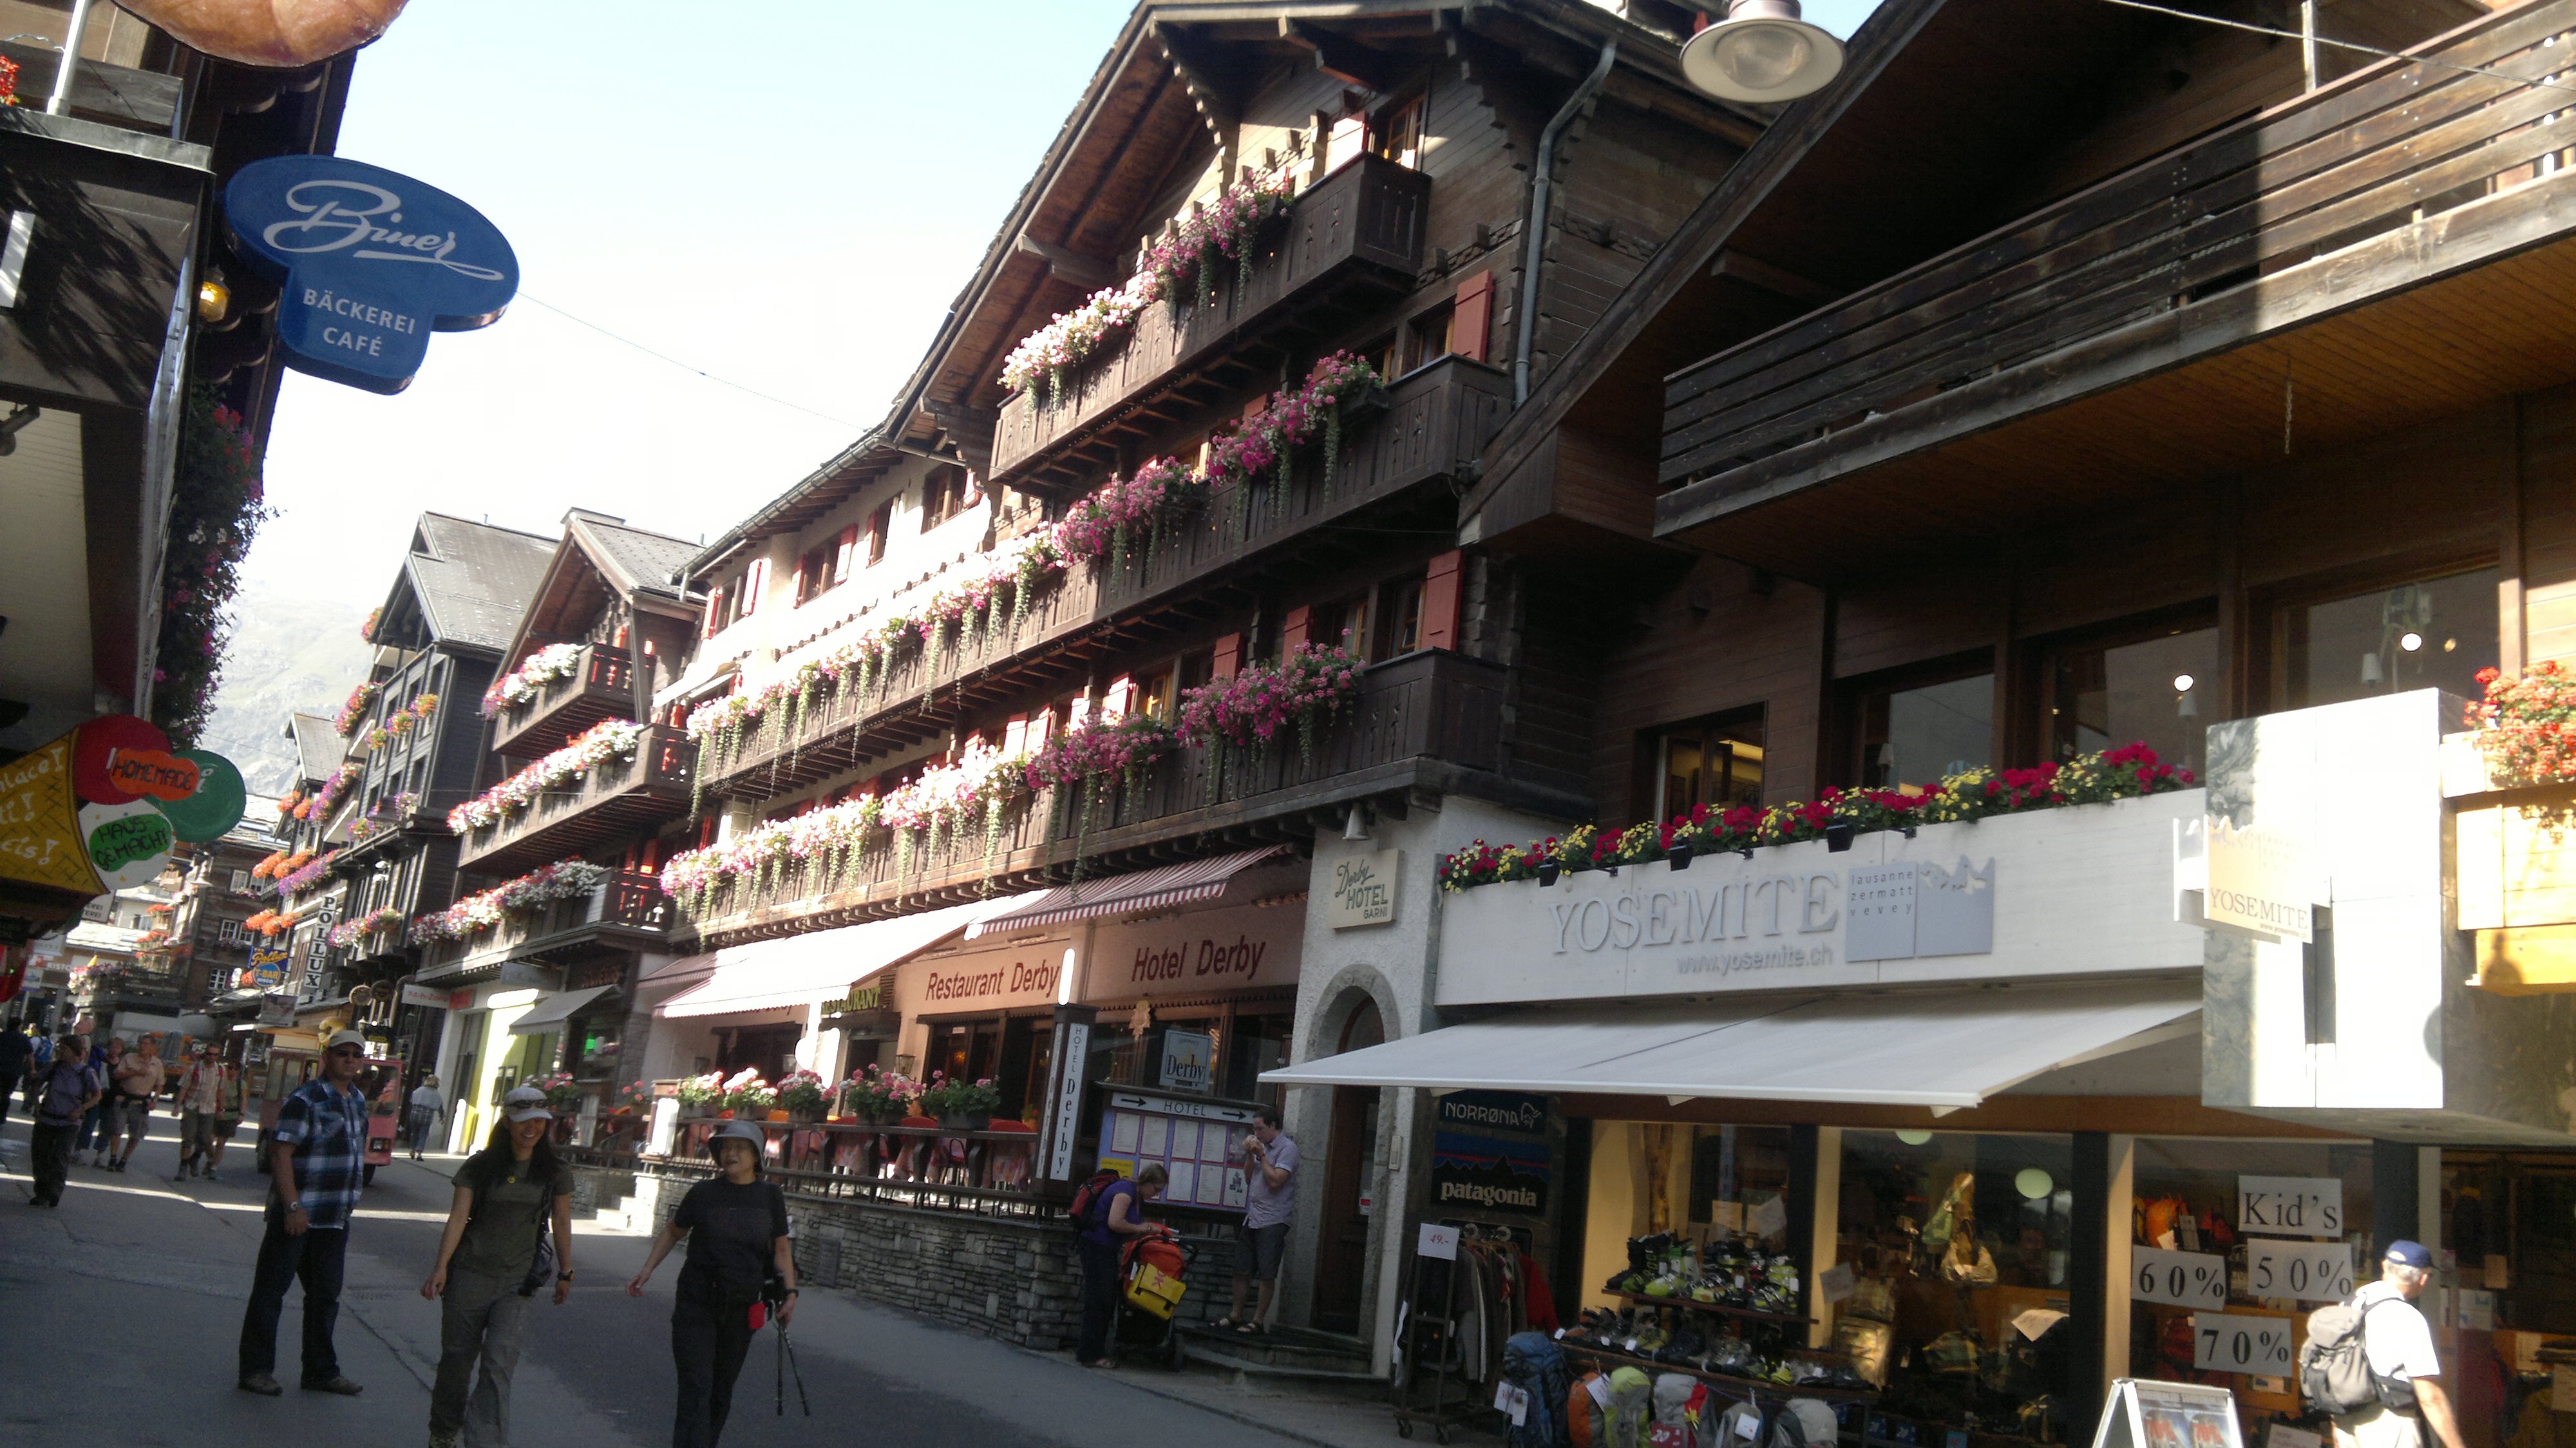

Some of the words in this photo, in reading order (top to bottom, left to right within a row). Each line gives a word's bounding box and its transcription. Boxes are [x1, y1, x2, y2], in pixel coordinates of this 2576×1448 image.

[263, 179, 505, 281] Biner
[303, 288, 416, 335] BÄCKEREI
[323, 326, 384, 357] CAFÉ
[97, 815, 147, 843] HAUS
[96, 828, 169, 872] GEMACHT
[1335, 859, 1375, 898] Derby
[1345, 884, 1388, 910] HOTEL
[1851, 886, 1912, 901] zermatt
[1852, 871, 1913, 886] lausanne
[1363, 906, 1388, 919] GARNI
[1548, 872, 1840, 955] YOSEMITE
[1850, 903, 1912, 916] vevey
[2210, 887, 2309, 930] YOSEMITE
[1130, 941, 1188, 983] Hotel
[1195, 934, 1266, 982] Derby
[1676, 941, 1834, 976] www.yosemite.ch
[925, 966, 1005, 1001] Restaurant
[1009, 958, 1061, 999] Derby
[1071, 1027, 1083, 1073] HOTEL
[1166, 1053, 1206, 1088] Derby
[1056, 1078, 1075, 1174] Derby
[1164, 1101, 1206, 1117] HOTEL
[1445, 1101, 1520, 1127] NORRØNA
[1440, 1181, 1537, 1206] patagonia
[2244, 1192, 2338, 1230] Kid's
[2139, 1262, 2224, 1299] 60%
[2257, 1256, 2352, 1297] 50%
[2201, 1328, 2289, 1365] 70%
